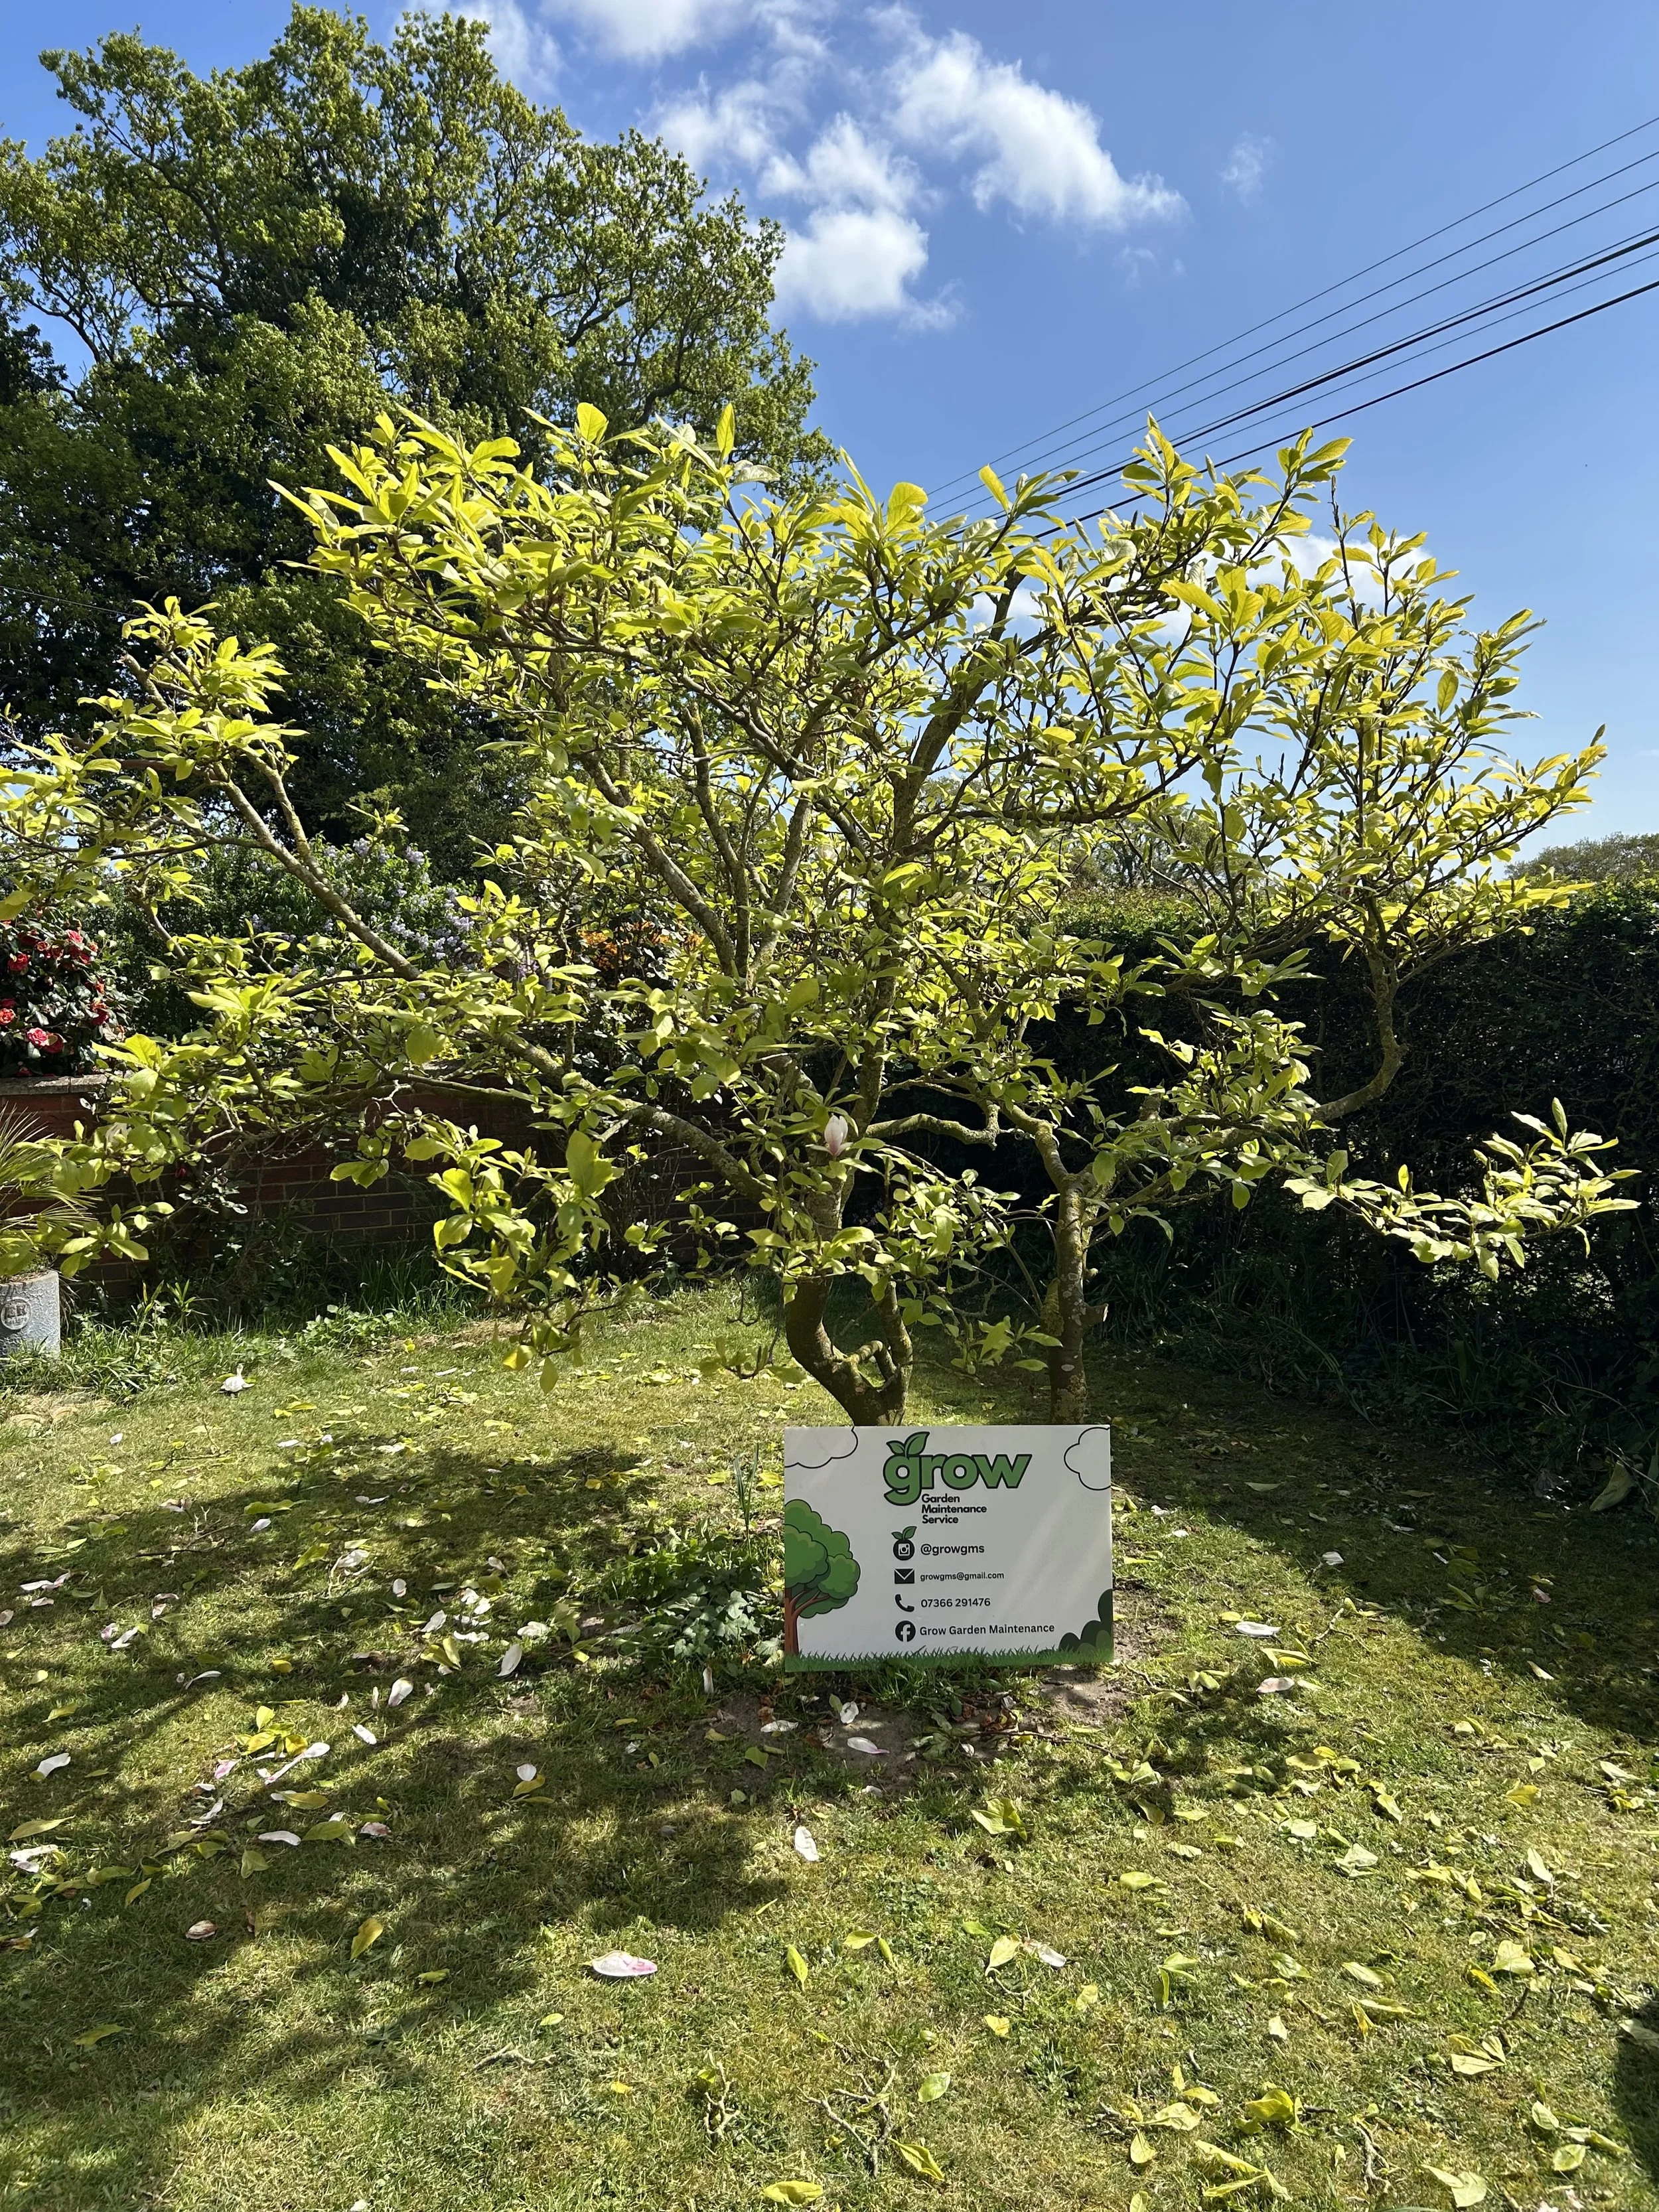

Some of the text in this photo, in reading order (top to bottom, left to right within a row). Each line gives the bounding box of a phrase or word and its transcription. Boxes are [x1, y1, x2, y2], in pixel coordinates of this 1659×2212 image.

[883, 1453, 1033, 1506] grow
[922, 1493, 960, 1503] Garden
[922, 1505, 987, 1513] Maintenance
[922, 1514, 958, 1524] Service
[920, 1544, 984, 1556] @growgms
[920, 1572, 1004, 1582] growgms@gmail.com
[921, 1598, 990, 1607] 07366 291476
[920, 1624, 1054, 1635] Grow Garden Maintenance
